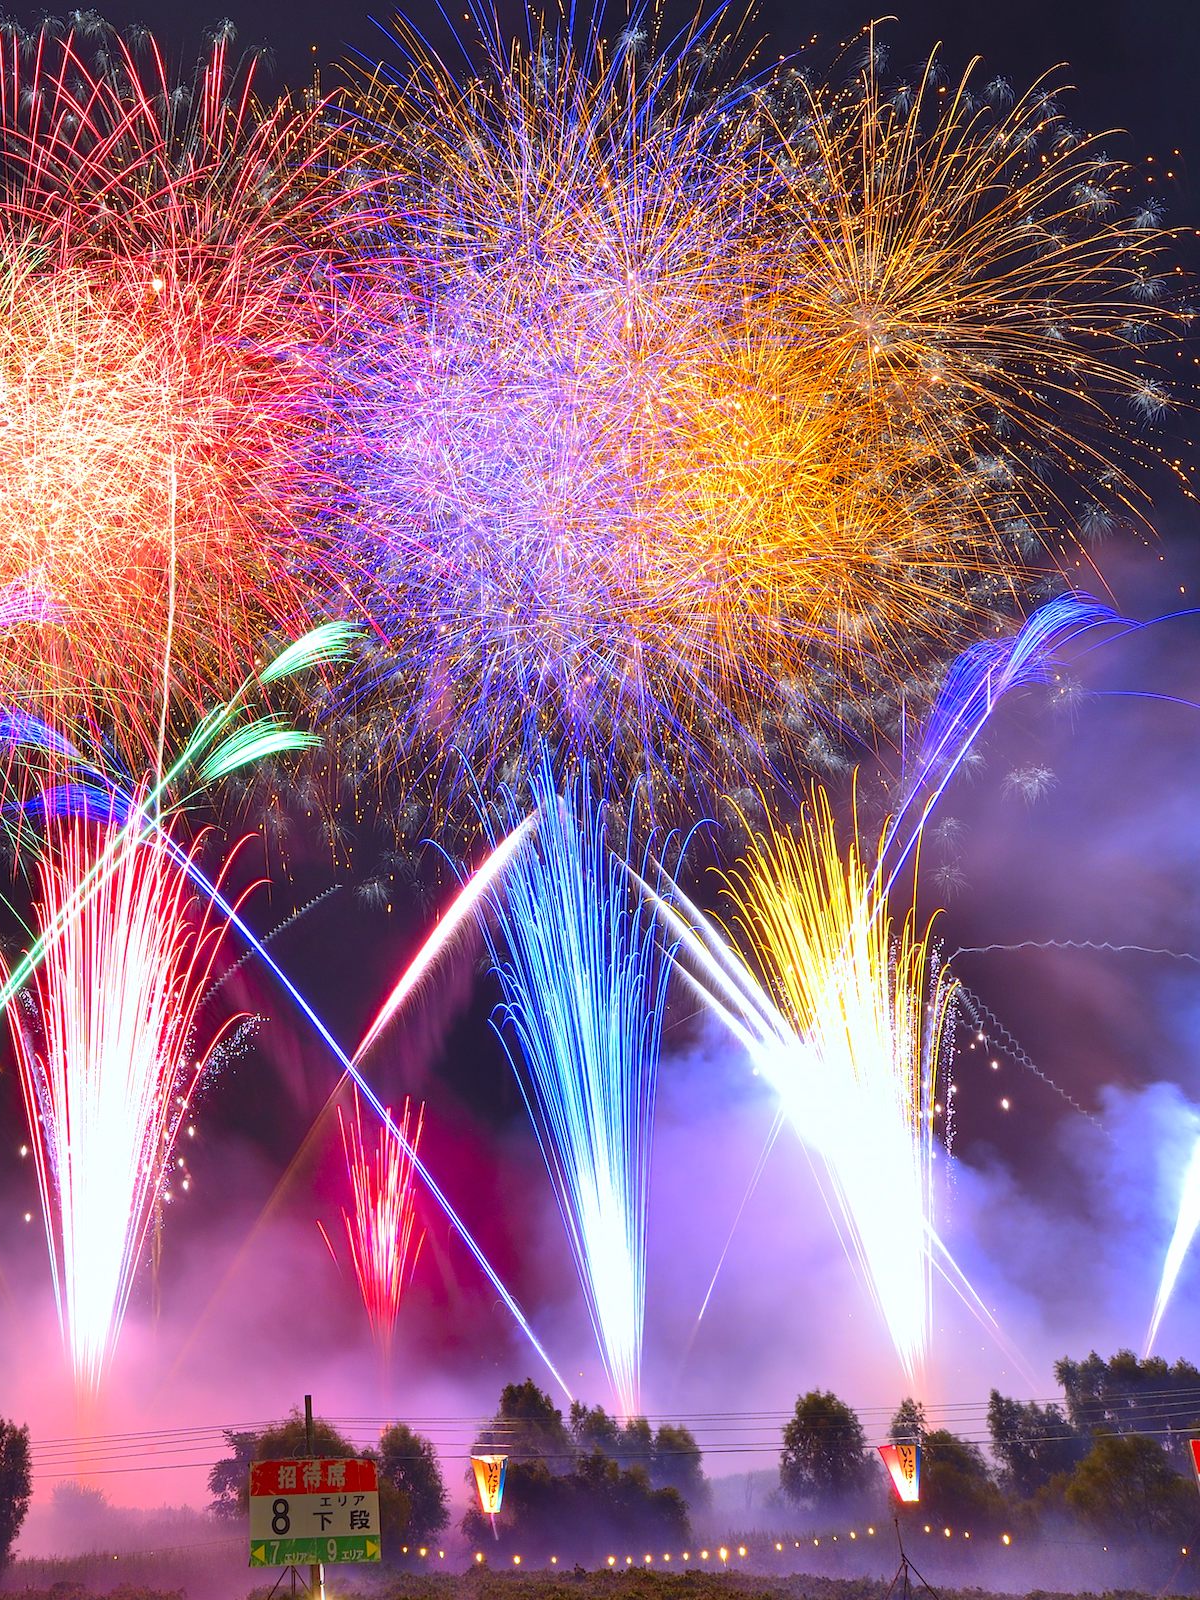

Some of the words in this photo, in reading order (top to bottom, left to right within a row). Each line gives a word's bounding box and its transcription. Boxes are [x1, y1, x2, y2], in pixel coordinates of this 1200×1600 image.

[278, 1460, 346, 1489] 招待席
[271, 1498, 291, 1535] 8
[320, 1495, 365, 1507] エリア
[270, 1541, 280, 1564] 7
[285, 1552, 308, 1563] エリア
[327, 1538, 337, 1562] 9
[341, 1549, 365, 1561] エリア
